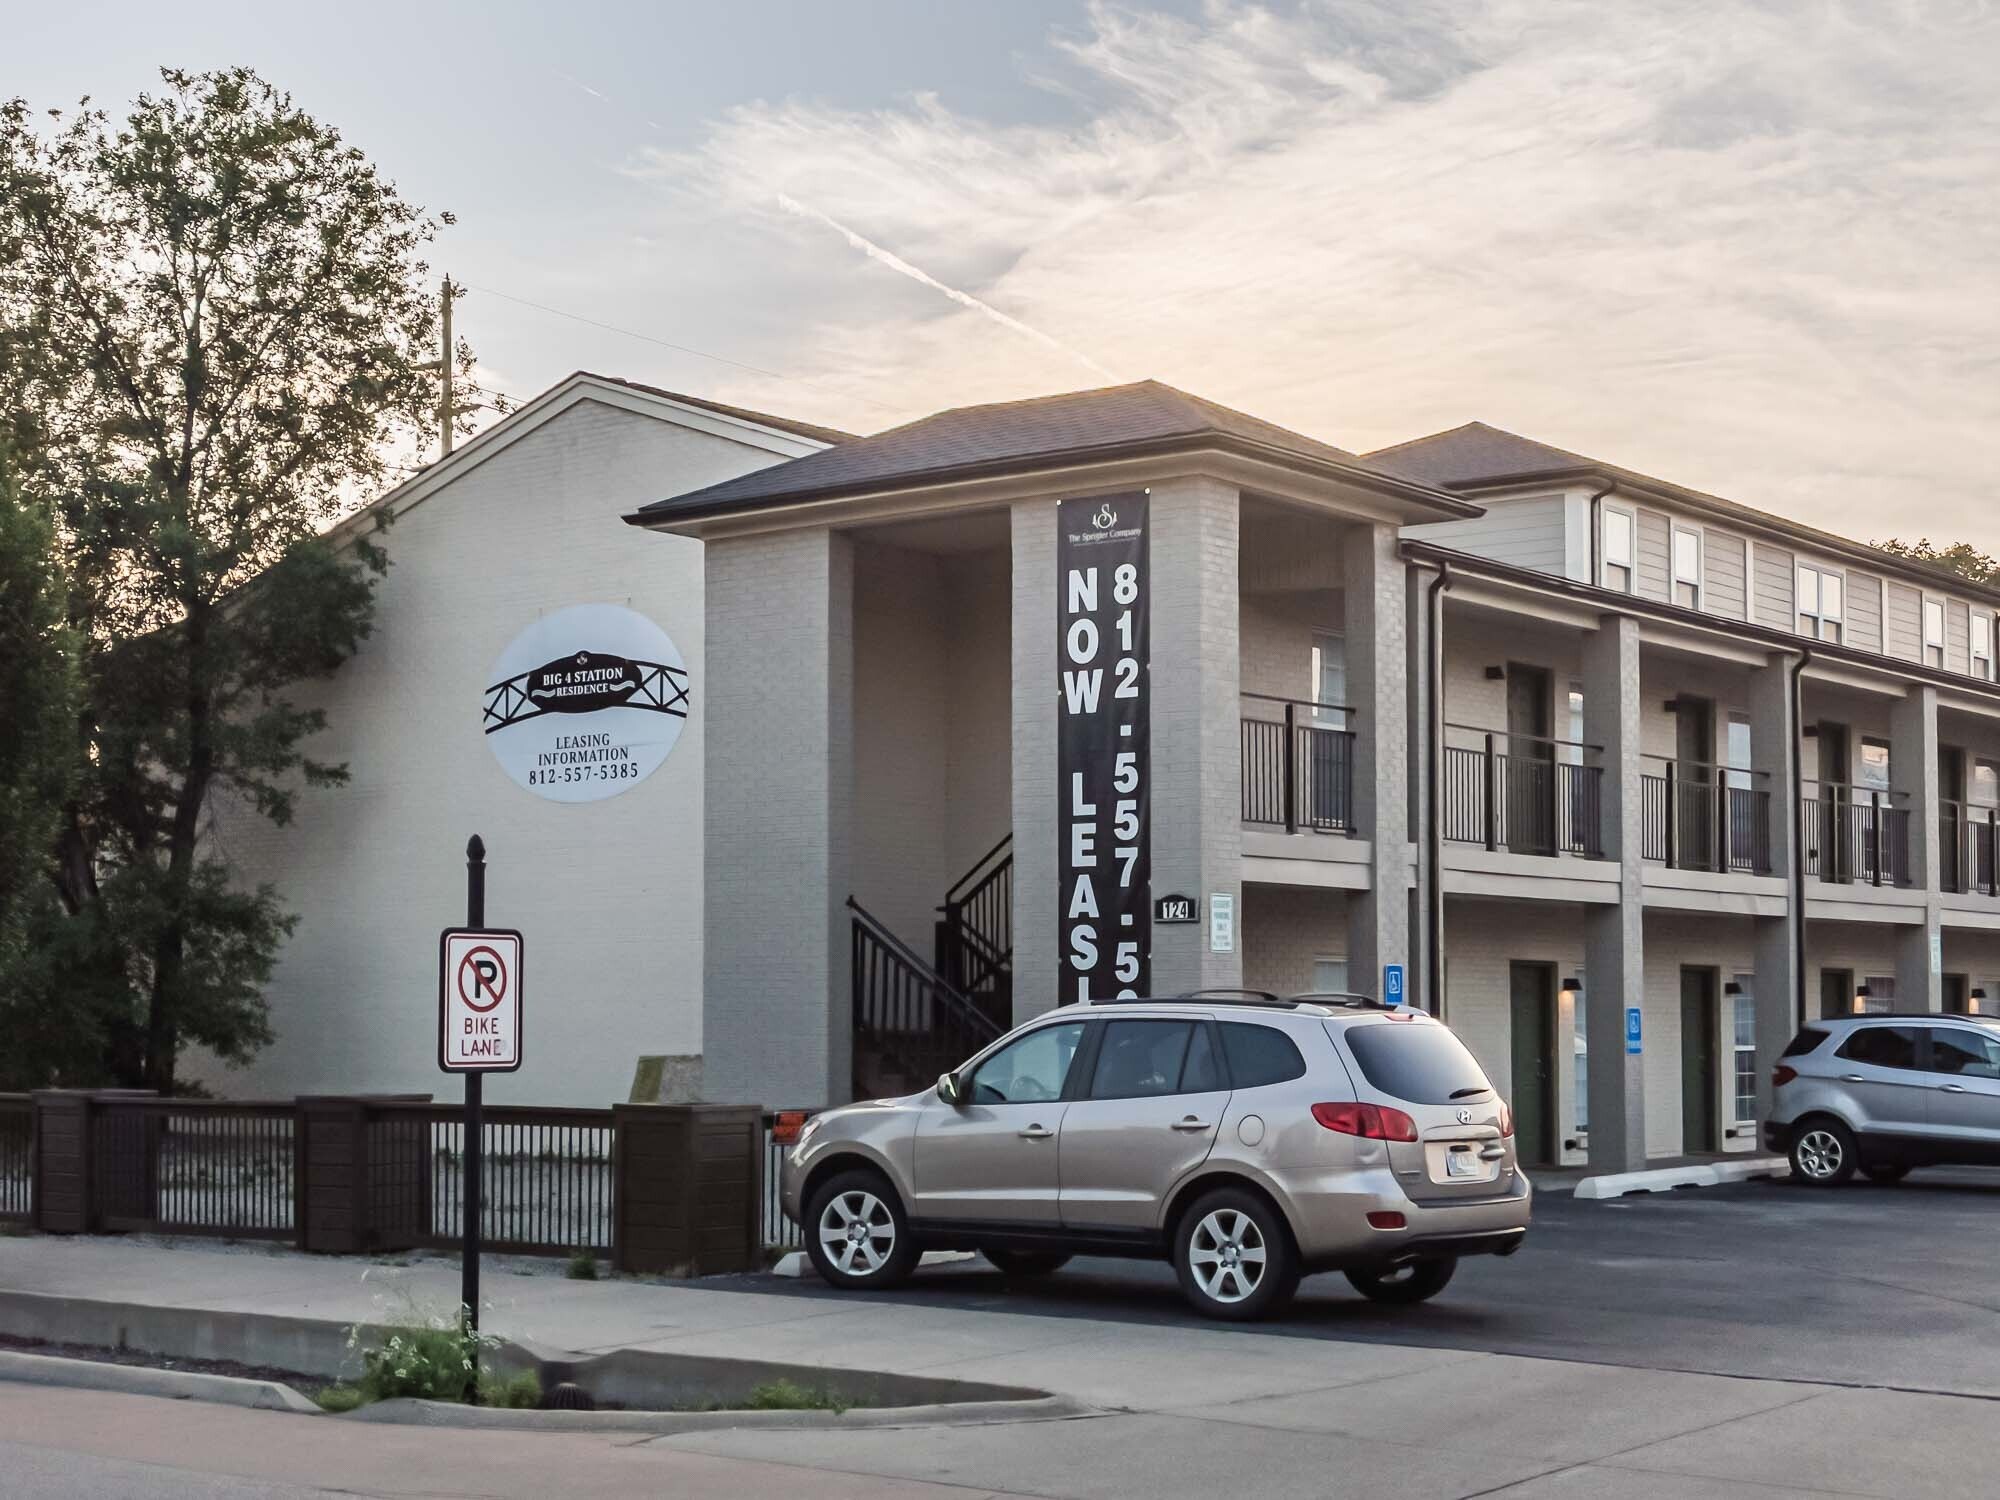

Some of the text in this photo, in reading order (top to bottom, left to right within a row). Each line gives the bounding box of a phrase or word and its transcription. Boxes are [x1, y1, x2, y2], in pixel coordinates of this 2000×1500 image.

[1068, 534, 1081, 543] The
[1109, 528, 1142, 538] Company
[1063, 567, 1104, 714] NOW
[543, 667, 622, 686] BIG 4 STATION
[556, 683, 609, 697] RESIDENCE
[556, 733, 610, 750] LEASING
[538, 747, 629, 766] INFORMATION
[529, 762, 638, 785] 812-557-5385
[1165, 901, 1187, 918] 124
[464, 1017, 499, 1035] BIKE
[461, 1039, 502, 1056] LANE
